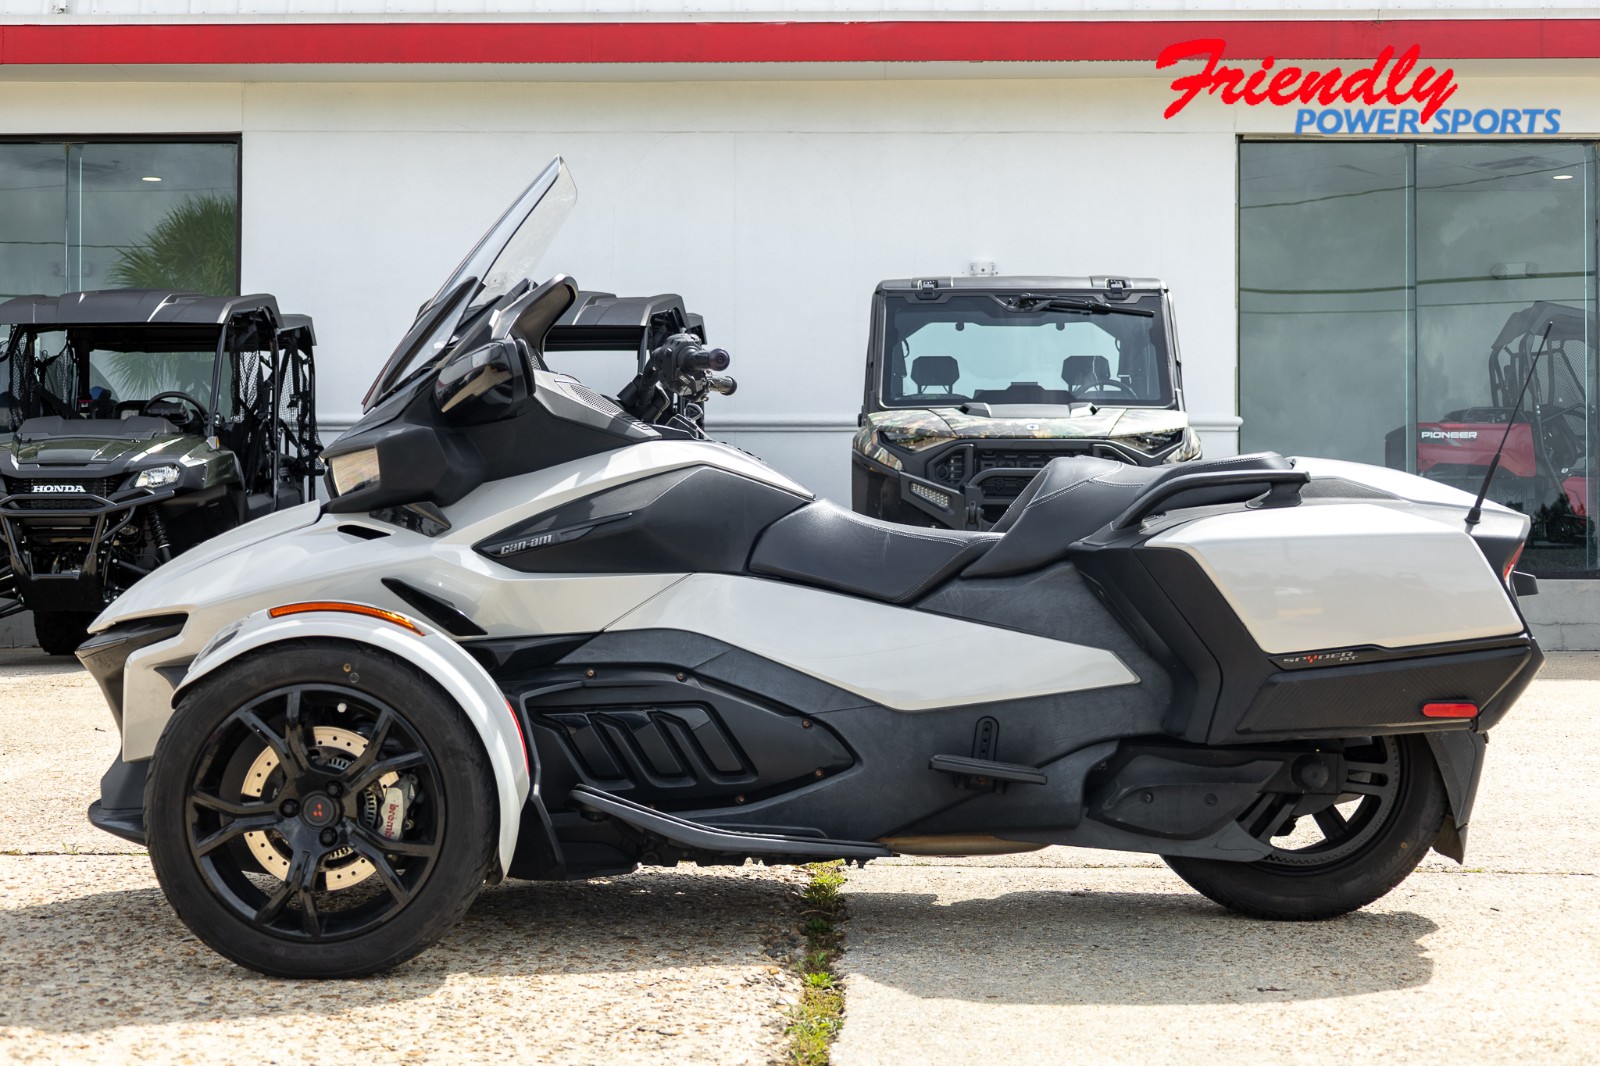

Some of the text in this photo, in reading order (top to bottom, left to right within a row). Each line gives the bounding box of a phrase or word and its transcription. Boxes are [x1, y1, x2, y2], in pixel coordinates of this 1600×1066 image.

[1421, 431, 1478, 439] PIONEER
[31, 485, 86, 493] HONDA
[500, 534, 553, 555] can-am
[384, 803, 399, 839] bremb
